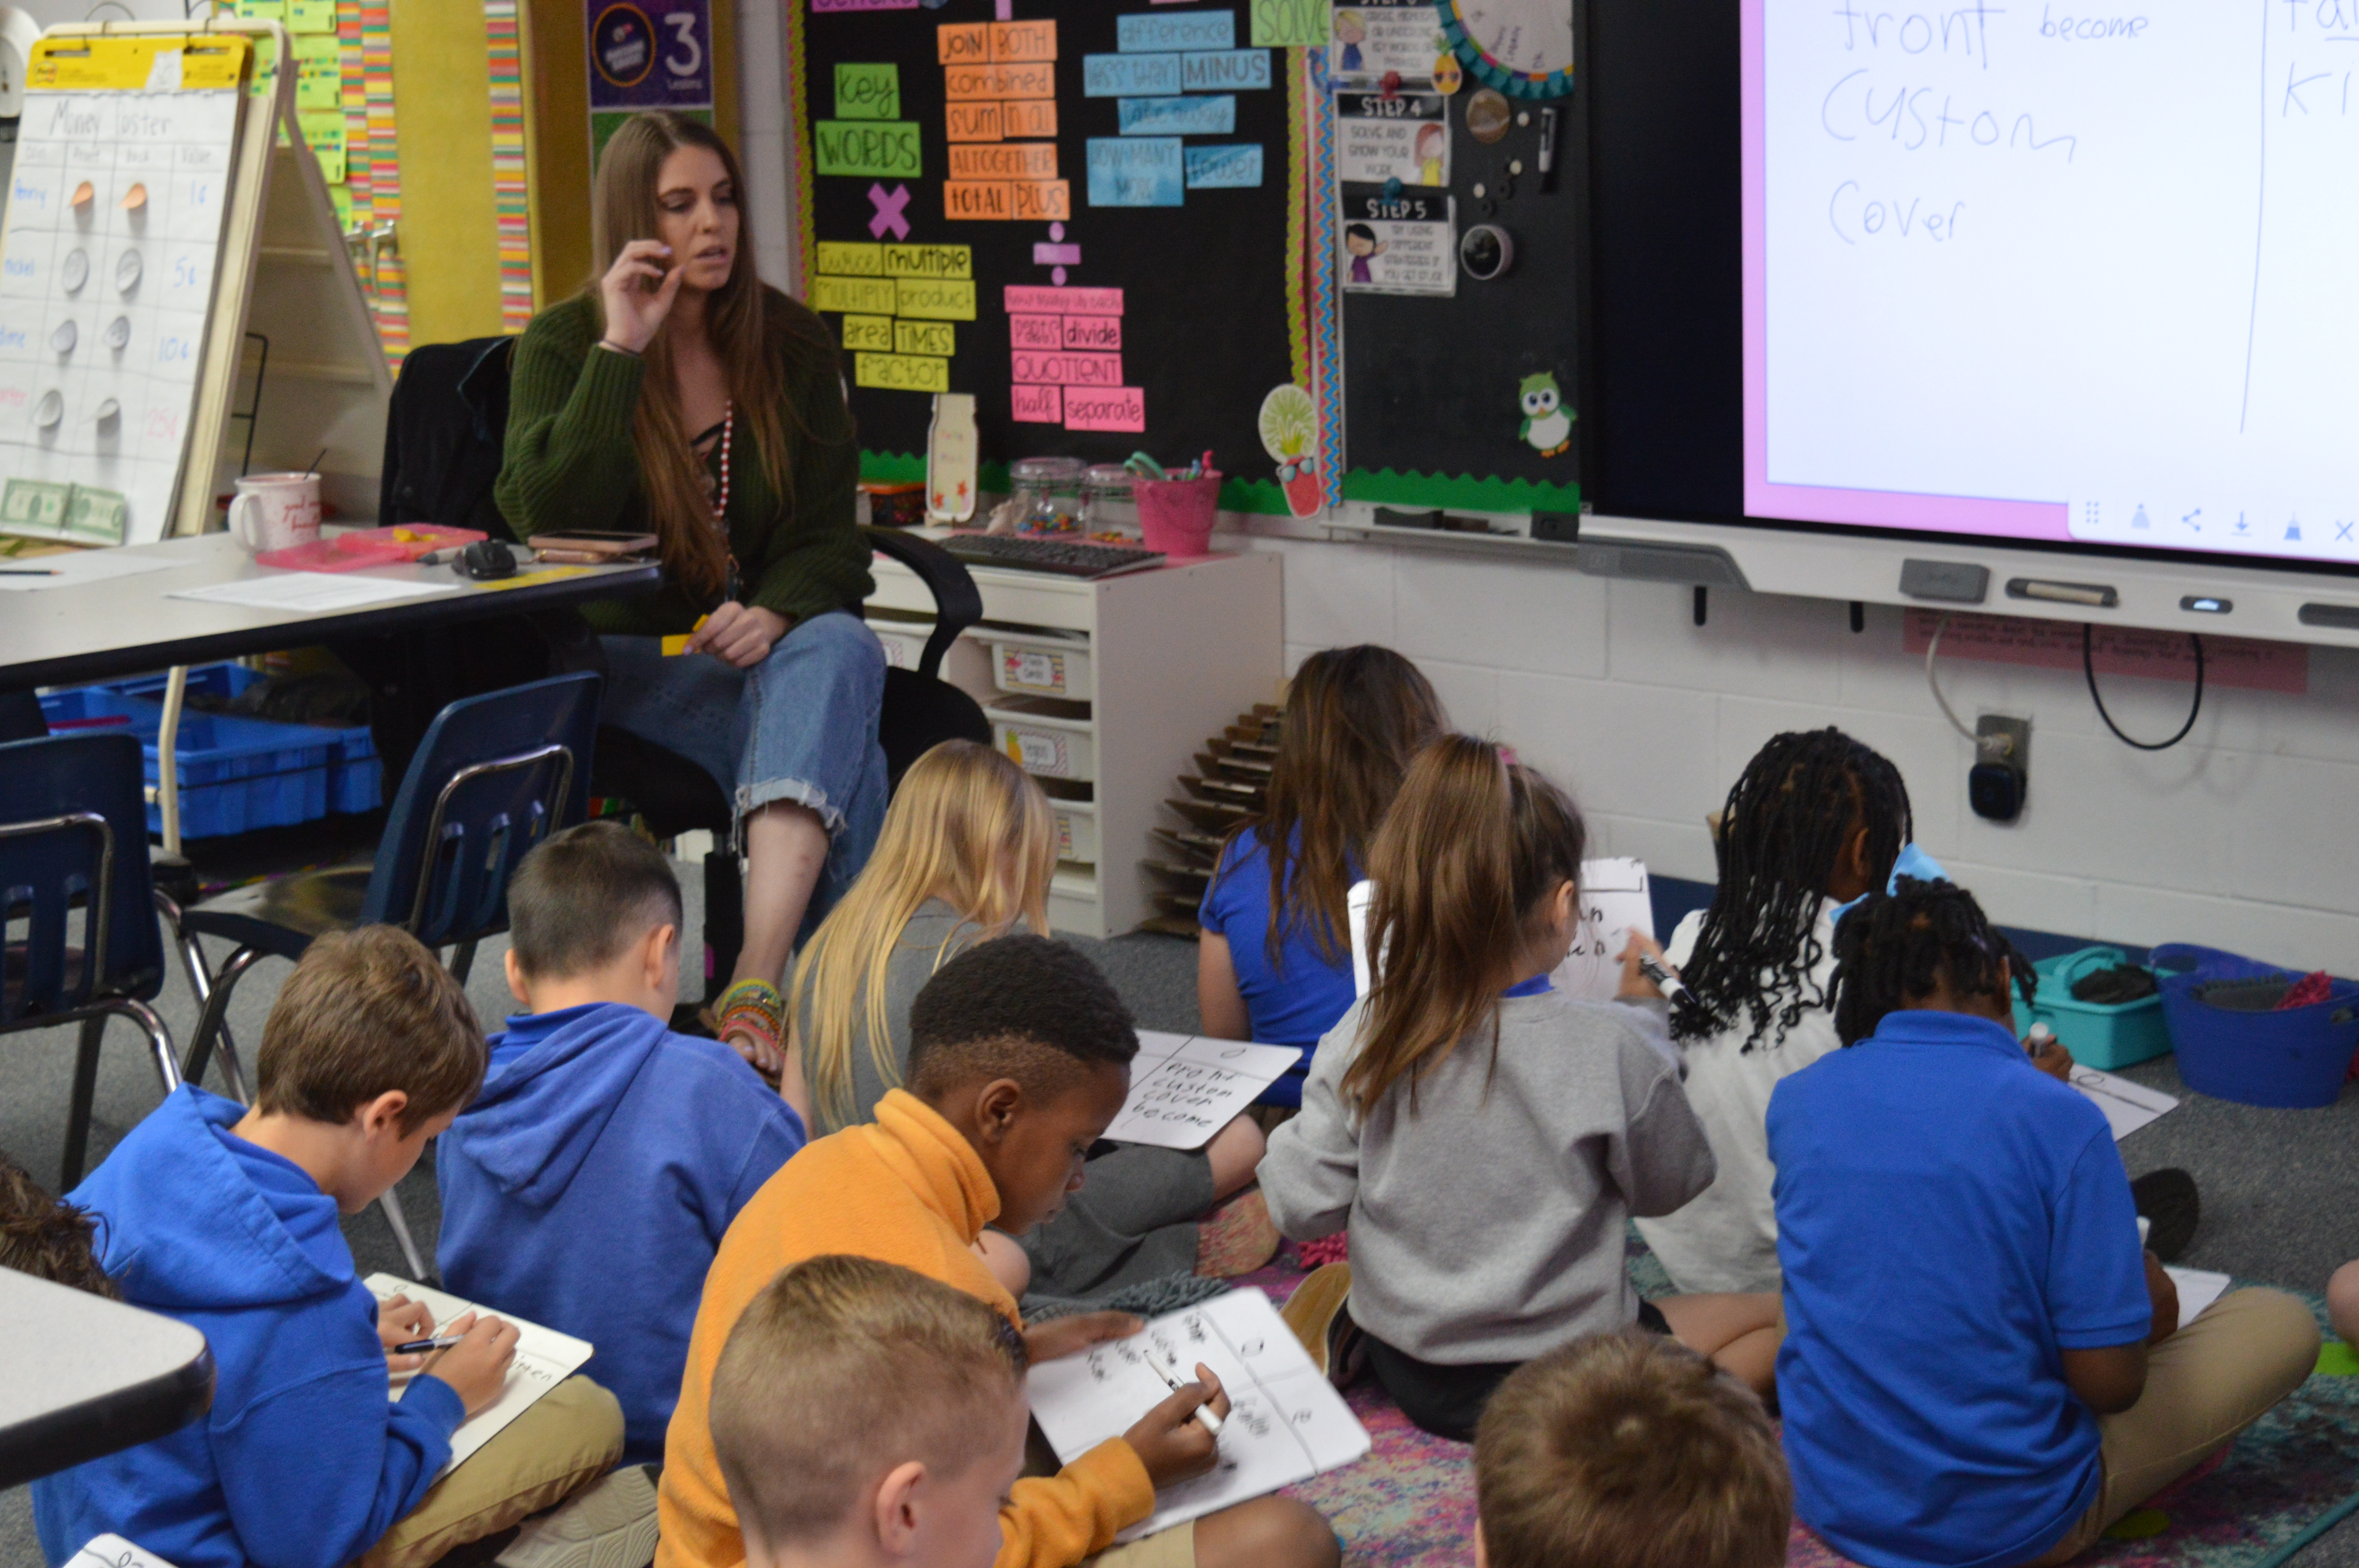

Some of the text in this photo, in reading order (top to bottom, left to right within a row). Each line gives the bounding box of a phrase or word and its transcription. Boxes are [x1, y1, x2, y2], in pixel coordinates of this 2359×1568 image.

[664, 12, 701, 76] 3
[947, 67, 1047, 94] combined
[1186, 54, 1267, 86] MINUS
[1410, 99, 1421, 116] 4
[1415, 200, 1427, 219] 5
[887, 249, 968, 276] multiple
[1066, 320, 1118, 345] divide
[1067, 393, 1141, 428] separate
